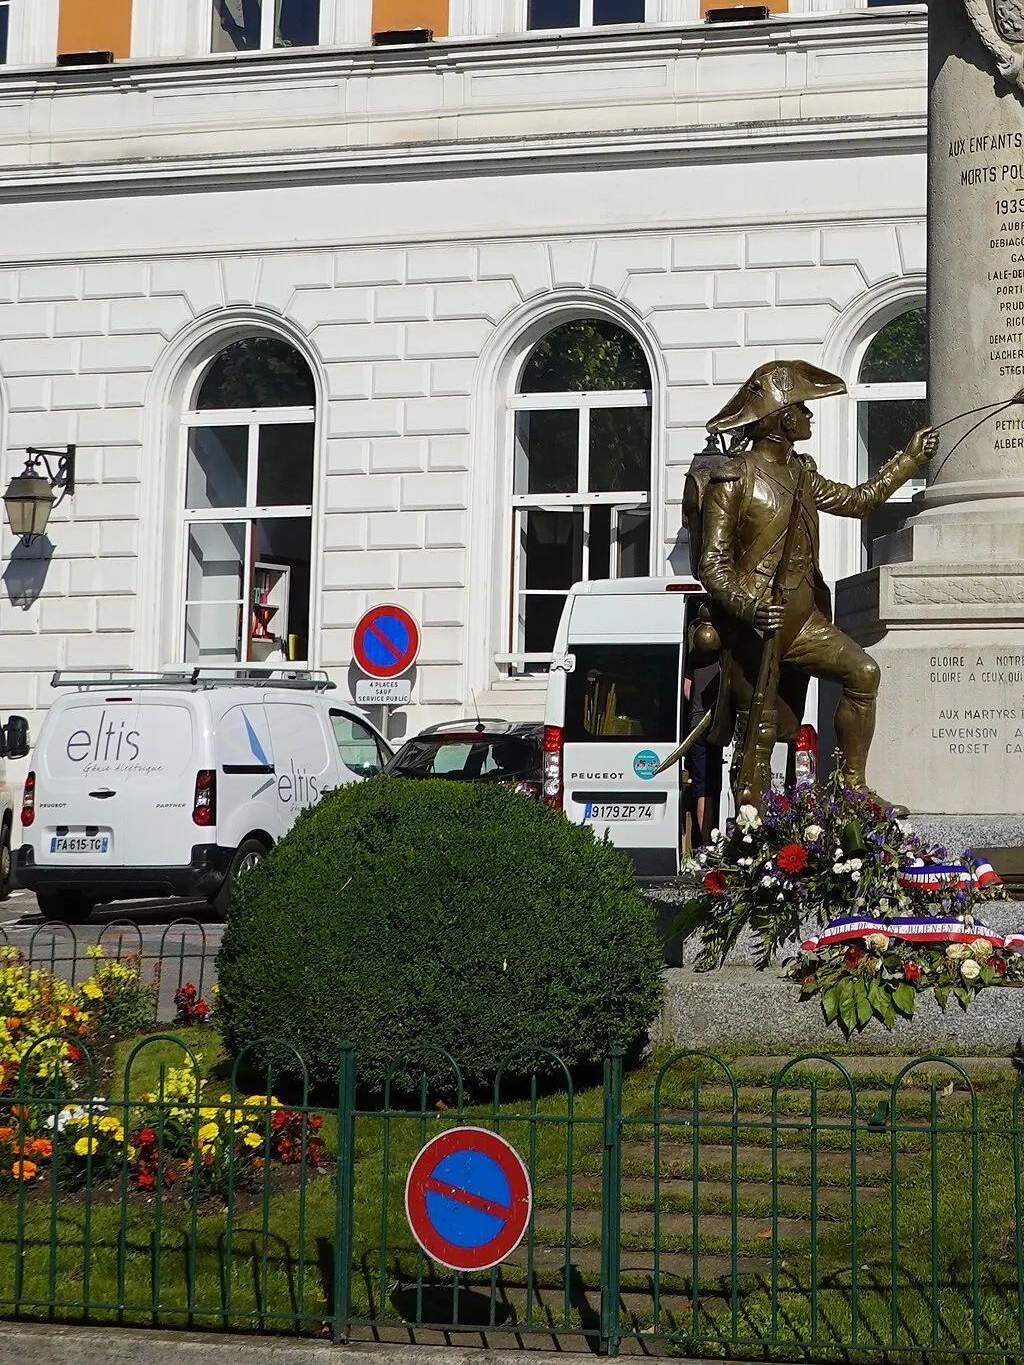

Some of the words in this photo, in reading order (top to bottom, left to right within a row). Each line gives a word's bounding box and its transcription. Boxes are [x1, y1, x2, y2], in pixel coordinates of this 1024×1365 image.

[949, 139, 966, 158] AUX
[969, 133, 1022, 154] ENFANTS
[961, 166, 997, 186] MORTS
[990, 350, 1024, 360] LACHER
[930, 656, 964, 667] GLOIRE
[976, 657, 984, 666] A
[930, 672, 961, 682] GLOIRE
[969, 672, 976, 682] A
[982, 672, 1004, 682] CEUX
[1008, 671, 1023, 683] QUI
[939, 709, 959, 719] AUX
[964, 709, 1016, 719] MARTYRS
[66, 710, 140, 762] eltis
[932, 728, 998, 738] LEWENSON
[949, 744, 989, 754] ROSET
[278, 758, 318, 802] eltis
[592, 806, 620, 818] 9179
[621, 806, 636, 818] ZP
[638, 806, 651, 818] 74
[56, 837, 101, 850] FA-615-TG
